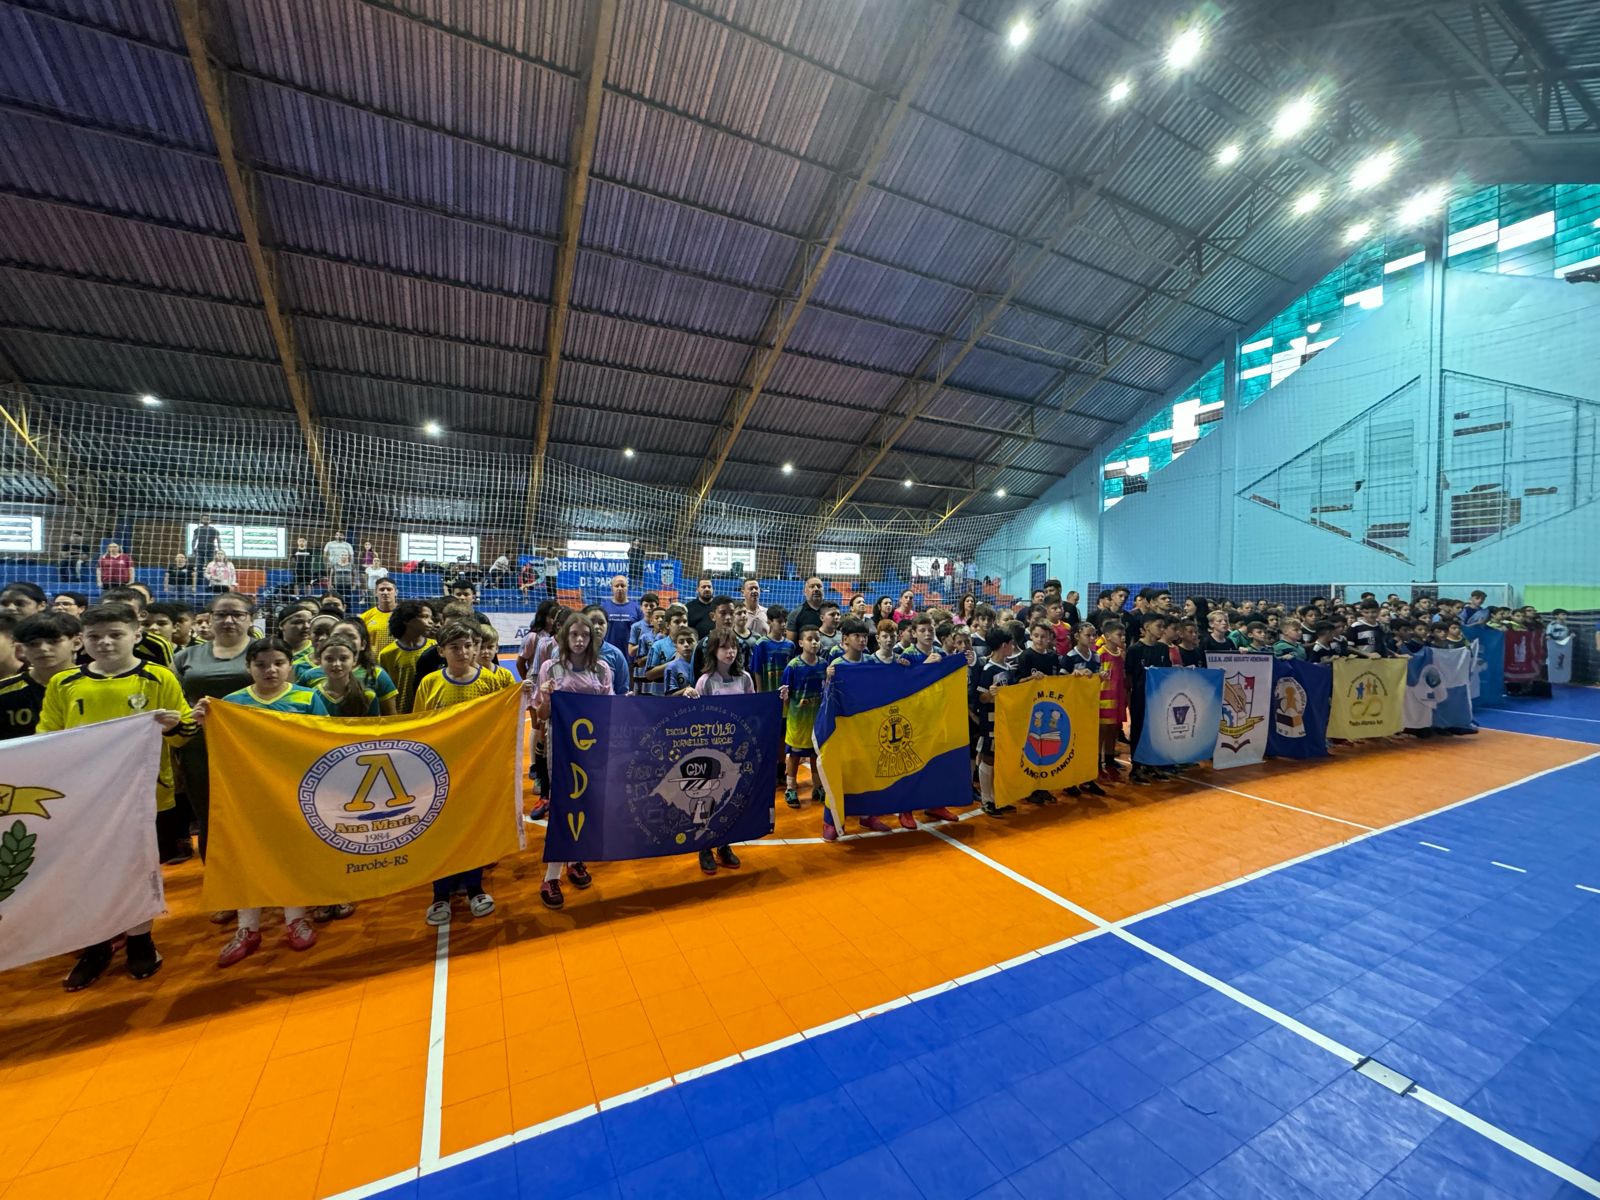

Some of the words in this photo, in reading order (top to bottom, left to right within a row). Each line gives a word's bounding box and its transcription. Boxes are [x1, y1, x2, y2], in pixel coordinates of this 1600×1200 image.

[559, 561, 604, 573] REFEITURA
[580, 576, 592, 587] DE
[76, 699, 84, 715] 1
[6, 708, 32, 726] 10
[665, 727, 688, 736] ESCOLA
[672, 738, 709, 748] DORNELLES
[711, 736, 733, 746] VARGAS
[334, 822, 369, 834] Ana
[371, 814, 420, 831] Maria
[364, 832, 391, 843] 1984
[345, 854, 409, 875] Parobé-RS
